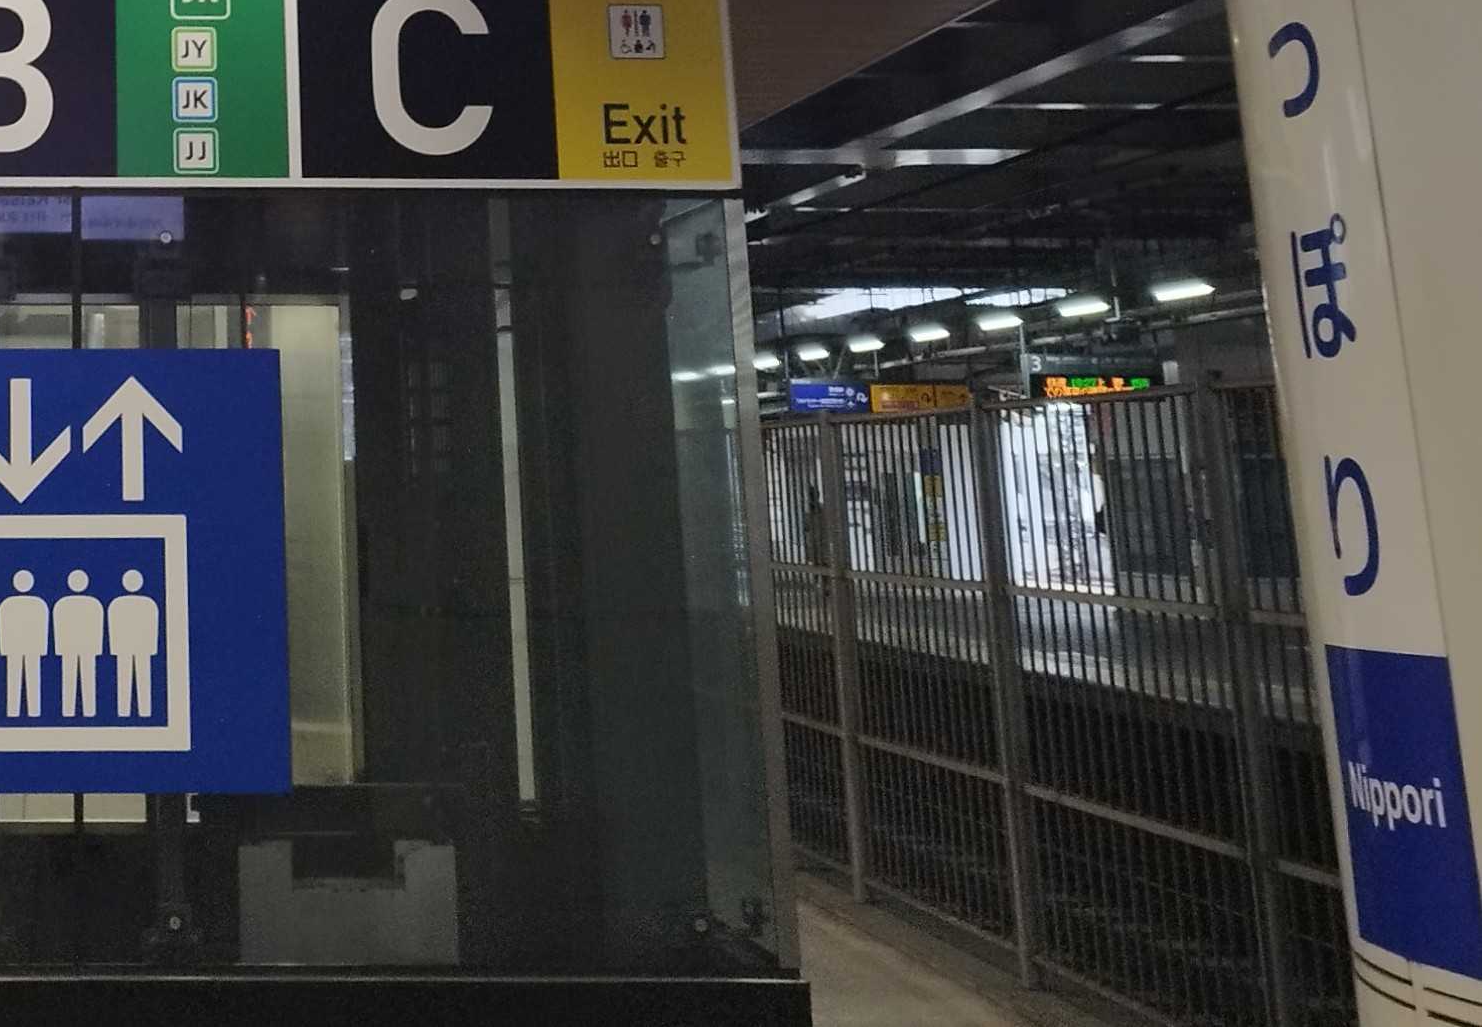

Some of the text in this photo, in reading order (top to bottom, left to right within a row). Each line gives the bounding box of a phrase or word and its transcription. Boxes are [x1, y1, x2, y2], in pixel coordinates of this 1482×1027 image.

[181, 39, 207, 58] JY
[182, 89, 208, 109] JK
[603, 102, 687, 146] Exit
[185, 141, 207, 161] JJ
[603, 150, 638, 168] 出口
[1030, 355, 1043, 372] 3
[1347, 760, 1447, 831] Nippori
